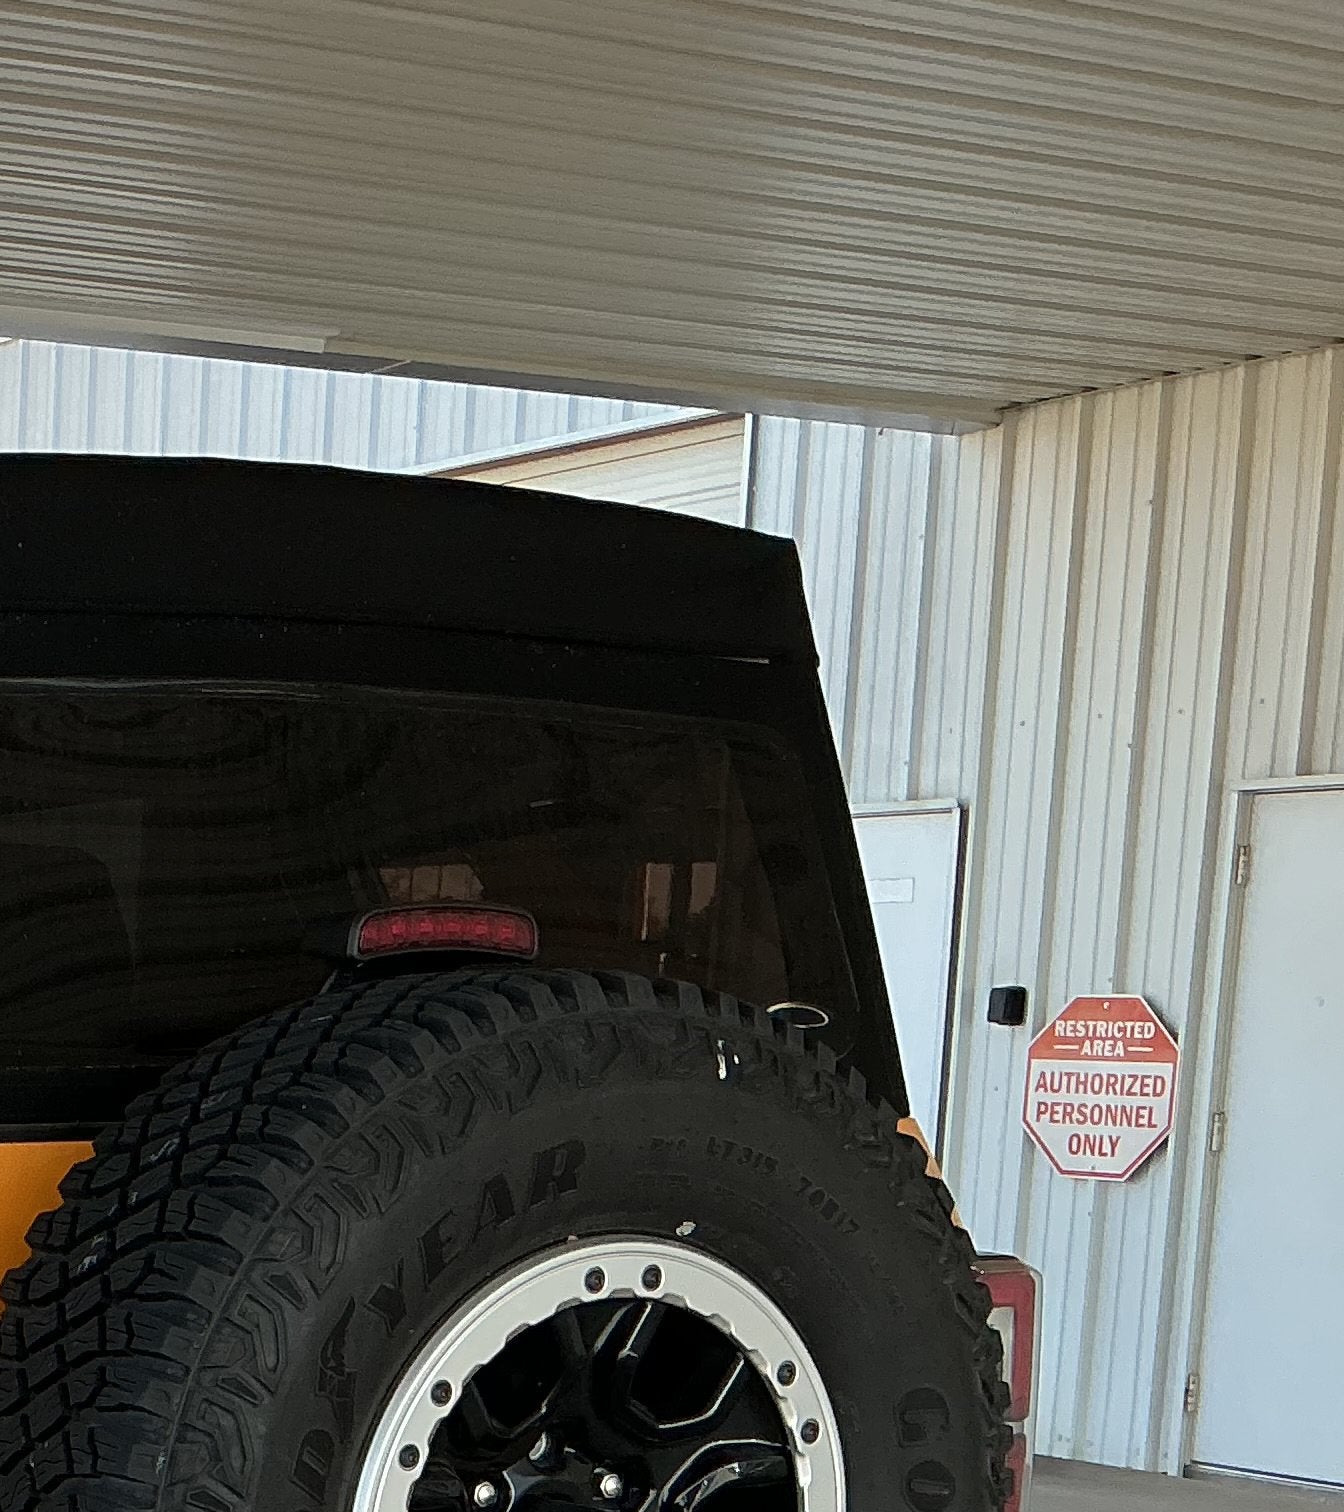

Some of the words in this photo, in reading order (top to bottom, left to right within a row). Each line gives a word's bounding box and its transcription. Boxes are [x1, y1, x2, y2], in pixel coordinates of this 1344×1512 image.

[1054, 1020, 1156, 1040] RESTRICTED
[1080, 1040, 1125, 1058] AREA
[1035, 1071, 1166, 1098] AUTHORIZED
[1035, 1101, 1158, 1129] PERSONNEL
[1068, 1133, 1121, 1158] ONLY
